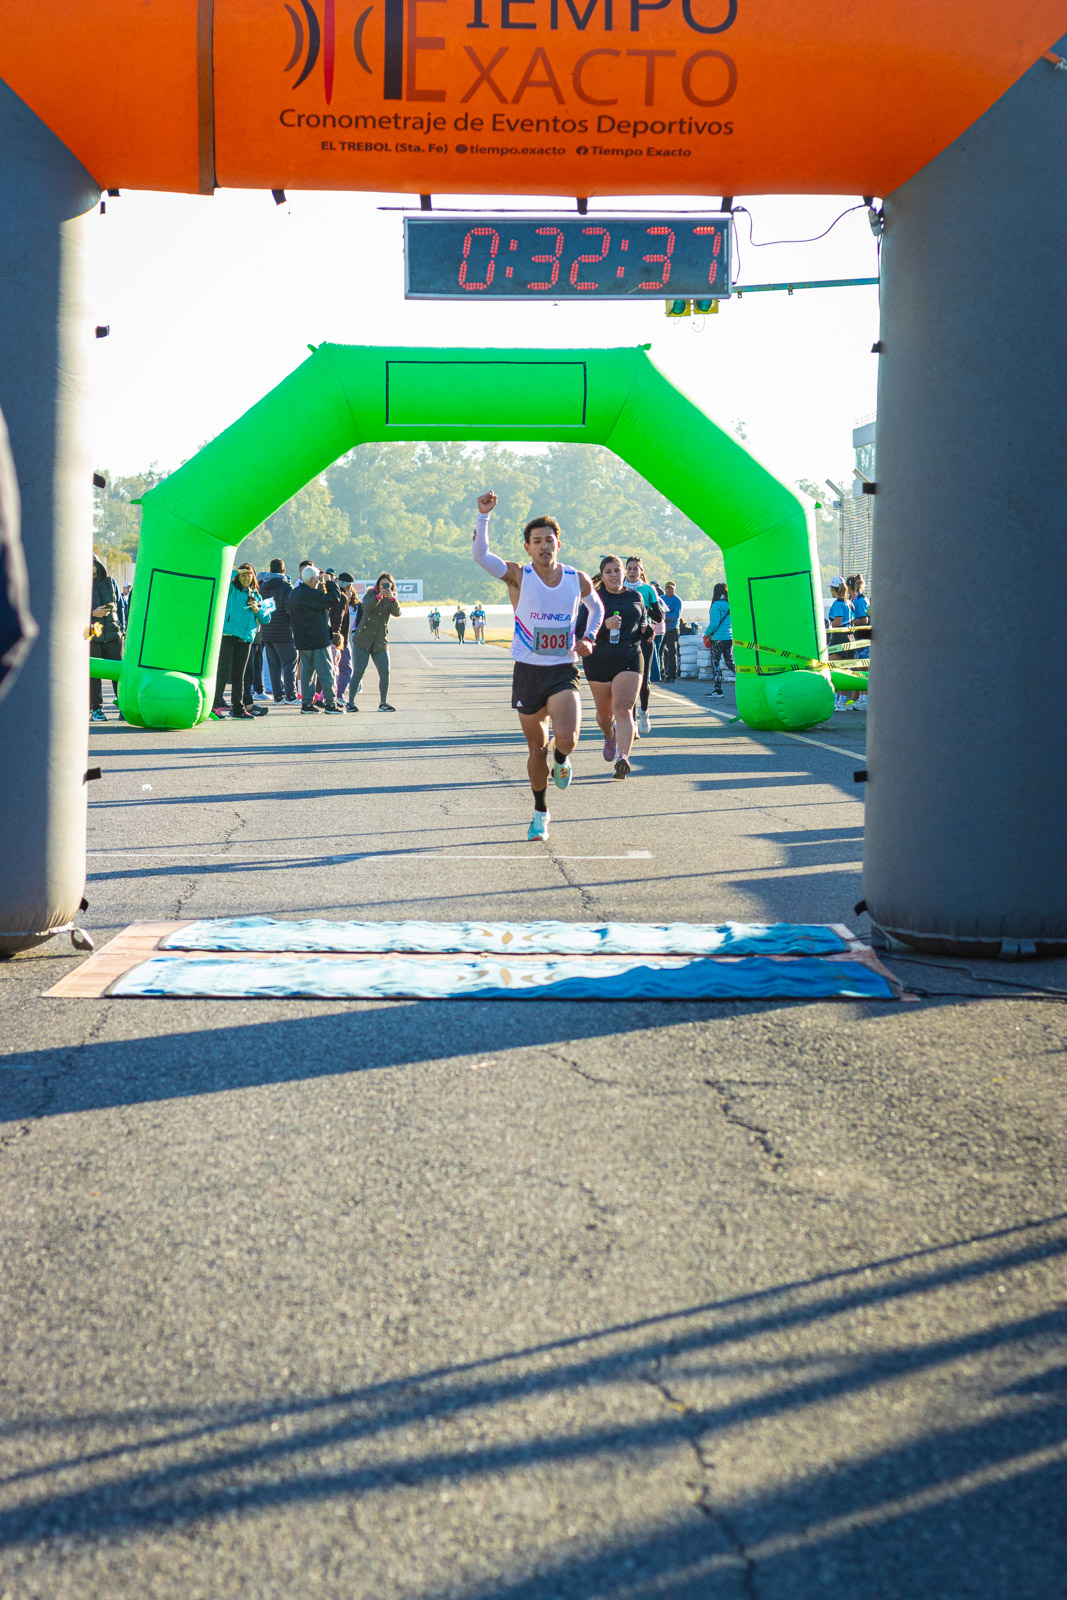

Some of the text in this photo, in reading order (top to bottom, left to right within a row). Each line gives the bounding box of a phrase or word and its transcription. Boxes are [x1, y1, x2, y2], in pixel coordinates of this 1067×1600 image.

[406, 0, 738, 107] EXACTO
[279, 108, 734, 139] Cronometraje de Eventos Deportivos
[320, 141, 692, 158] EL TREBOL (Sta. Fe) tiempo.exacto Tiempo Exacto
[458, 226, 721, 290] 0:32:37
[529, 612, 571, 622] RUNNEA
[540, 633, 566, 650] 303
